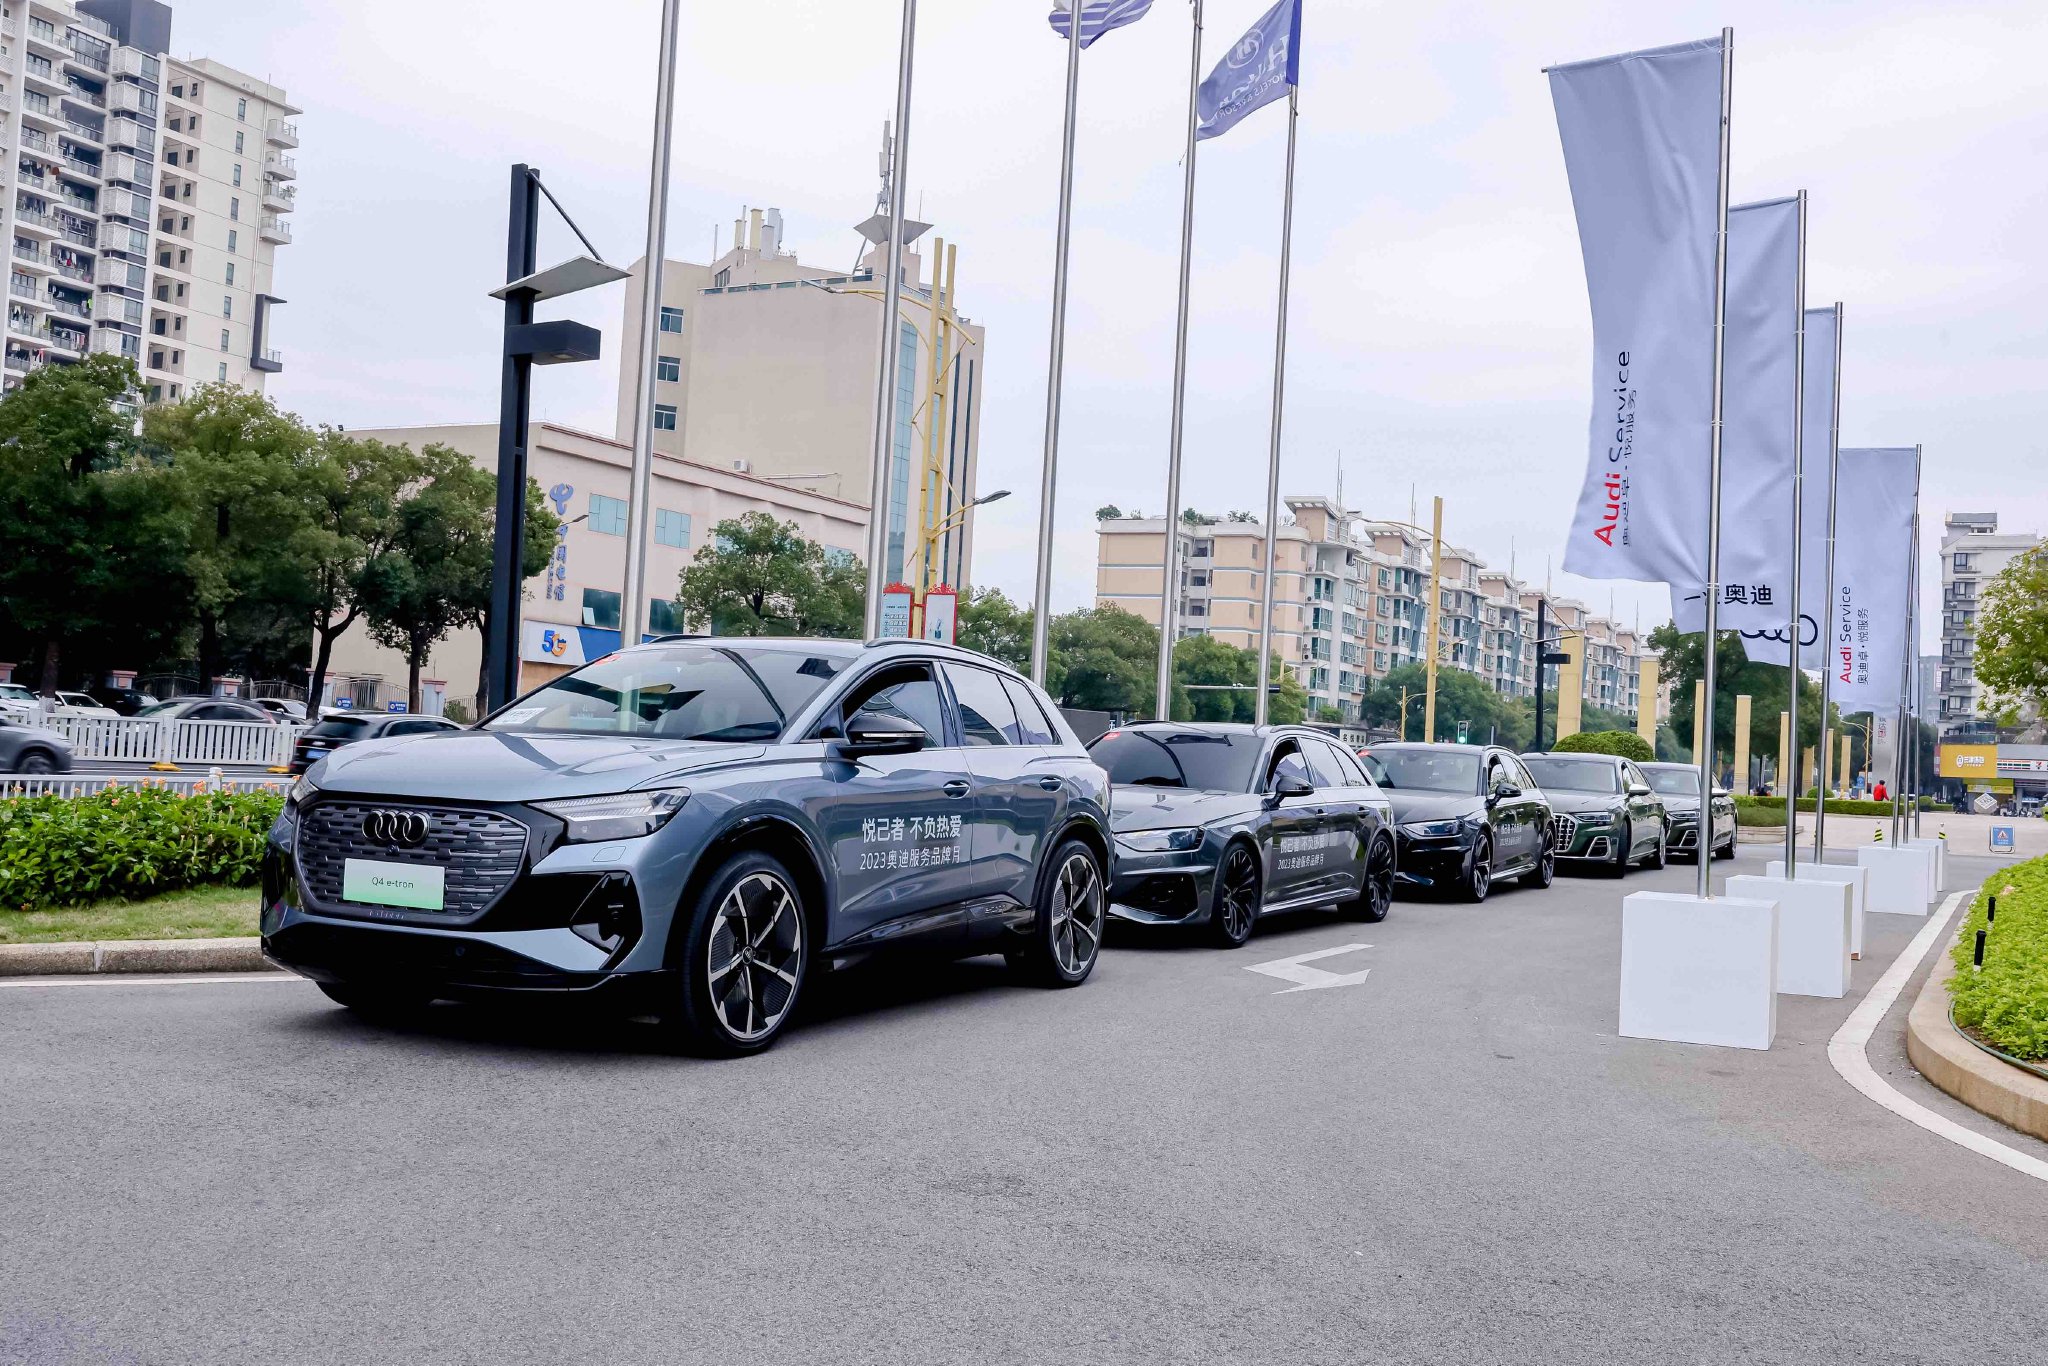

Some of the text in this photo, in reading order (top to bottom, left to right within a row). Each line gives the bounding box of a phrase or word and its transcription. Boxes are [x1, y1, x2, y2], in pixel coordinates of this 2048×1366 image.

[1594, 352, 1630, 547] Audi Service
[1684, 584, 1774, 606] 一奥迪
[542, 629, 567, 657] 5G
[1840, 586, 1852, 684] Audi Service
[1858, 608, 1869, 685] 奥迪卓·悦服务
[862, 815, 962, 843] 悦己者 不负热爱
[860, 845, 961, 870] 2023奥迪服务品牌月
[371, 876, 414, 889] Q4 e-tron
